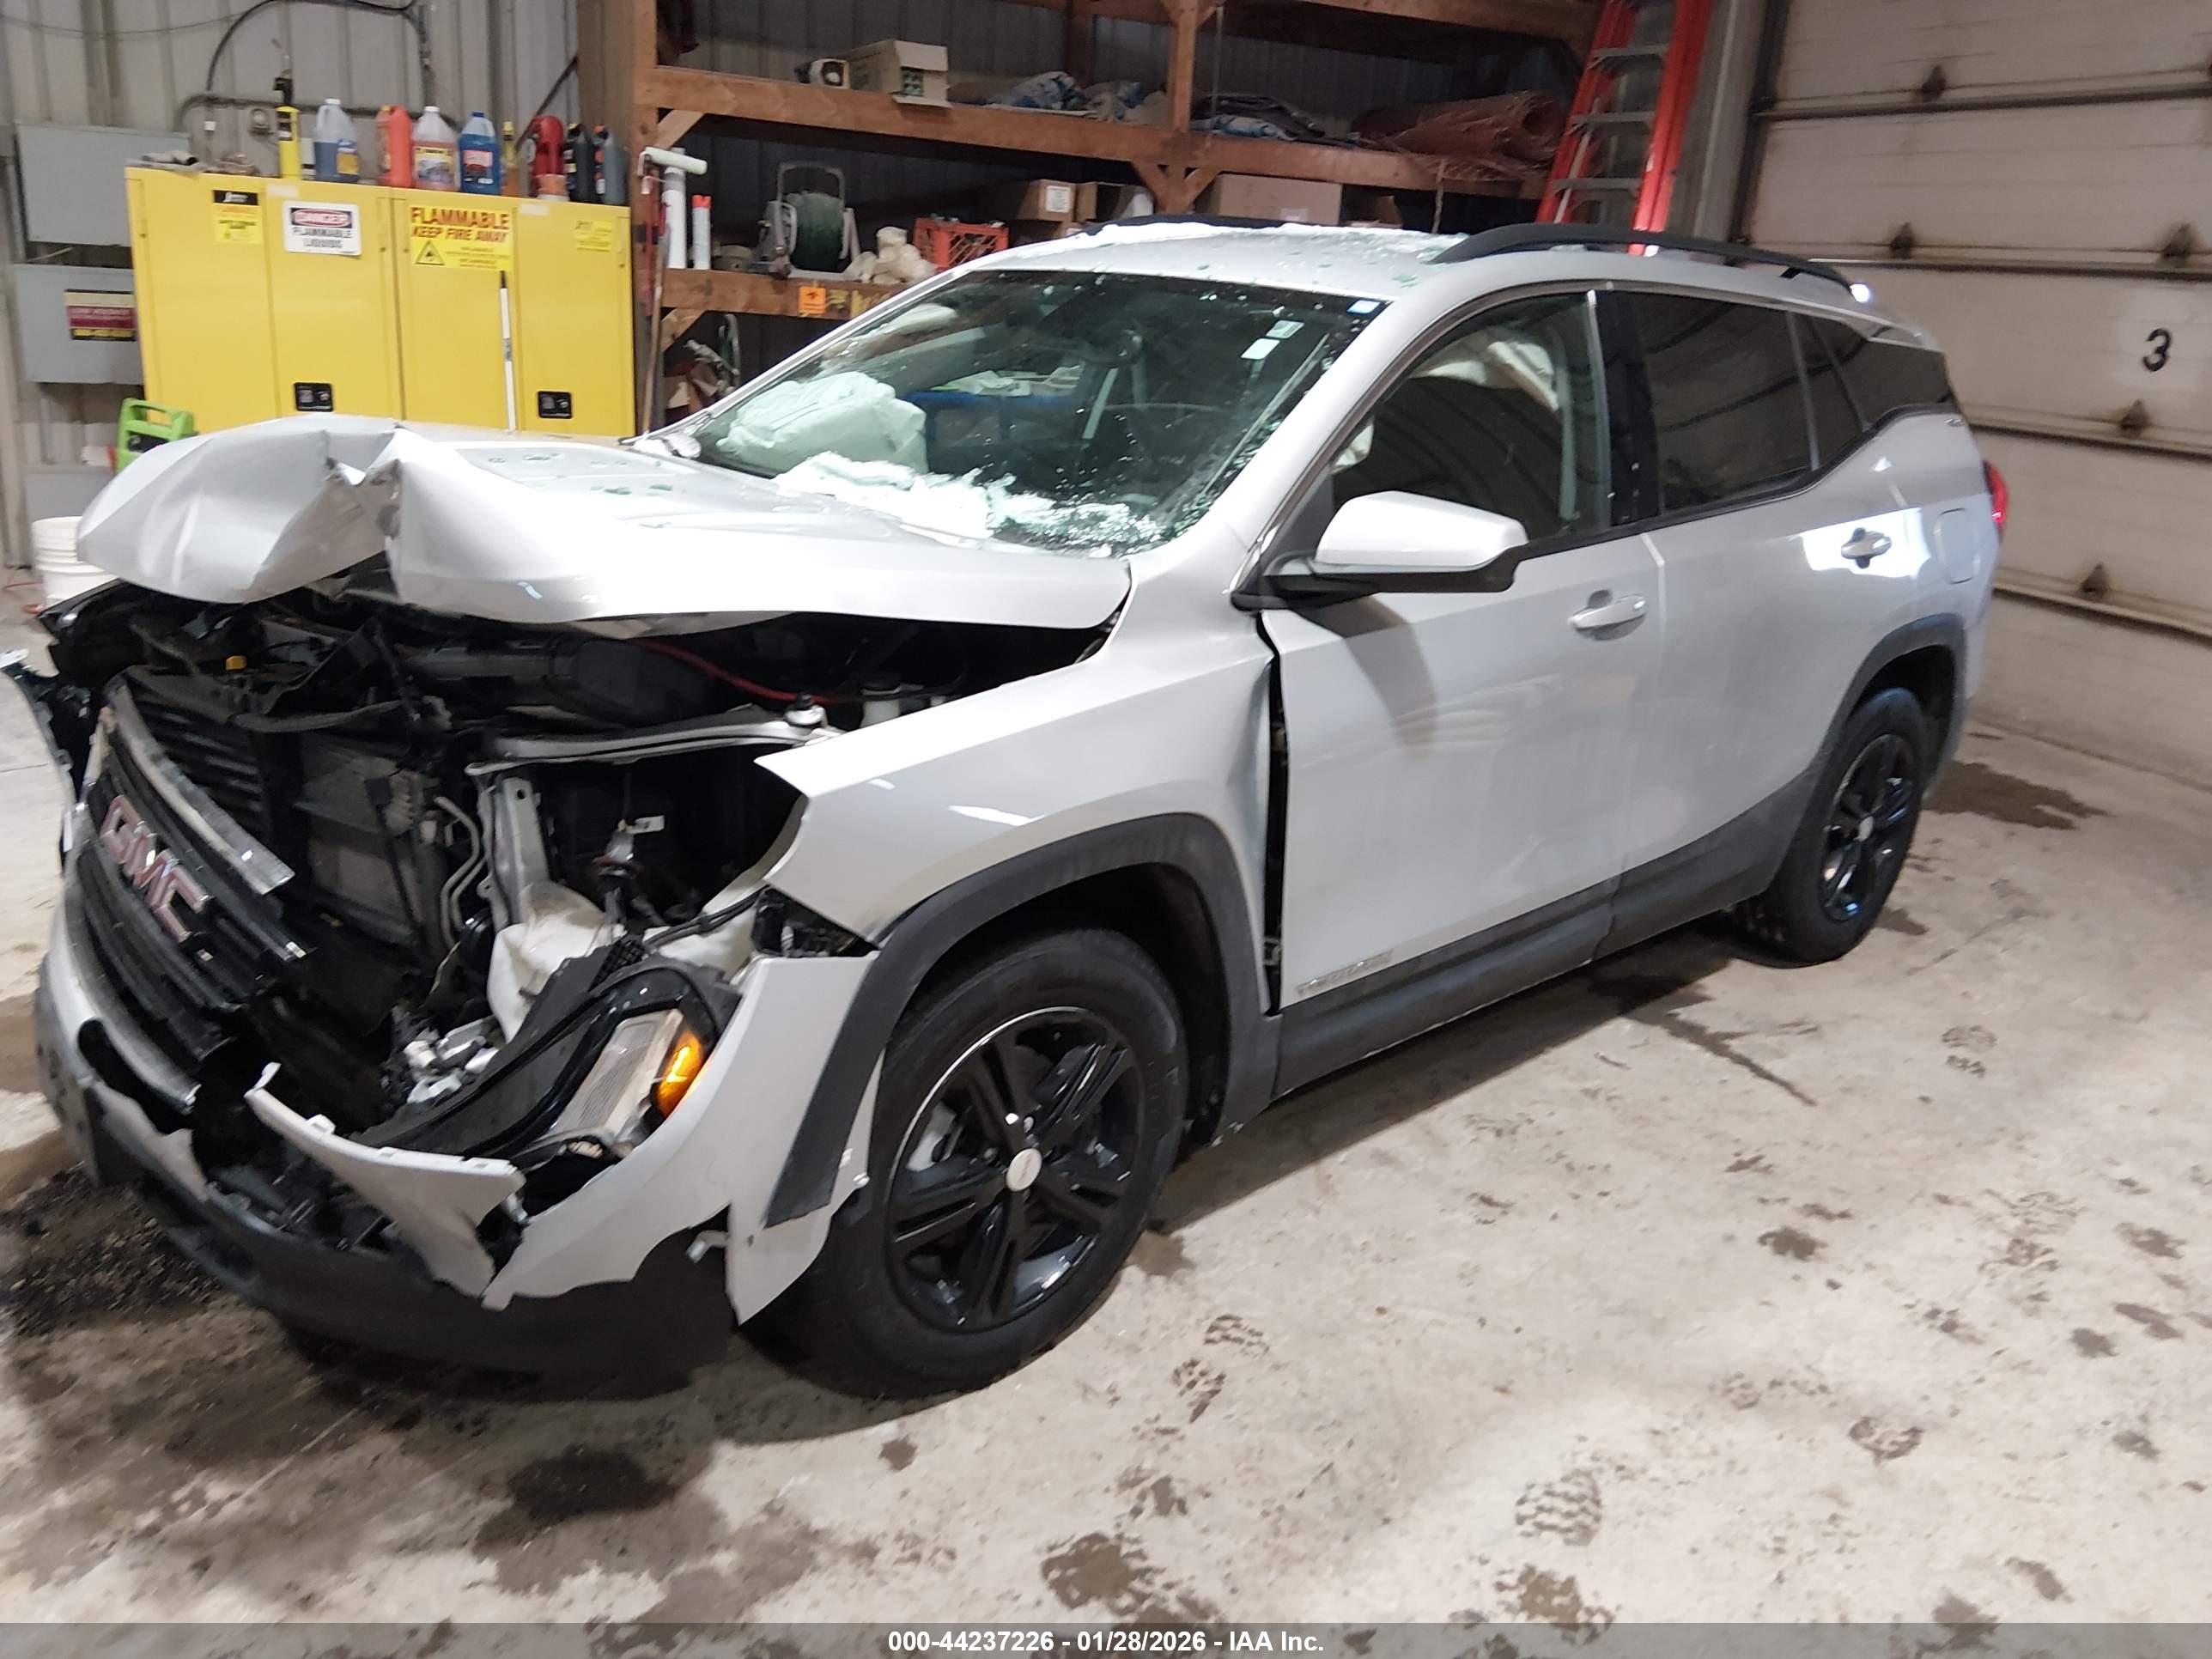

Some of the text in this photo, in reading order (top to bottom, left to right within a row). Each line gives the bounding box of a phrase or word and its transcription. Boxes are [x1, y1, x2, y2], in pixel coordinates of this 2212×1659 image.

[295, 212, 349, 224] DANGER
[411, 207, 509, 229] FLAMMABLE
[292, 227, 353, 238] FLAMMABLE
[412, 226, 507, 242] KEEP FIRE AWAY
[2142, 329, 2171, 372] 3
[100, 794, 212, 943] GMC
